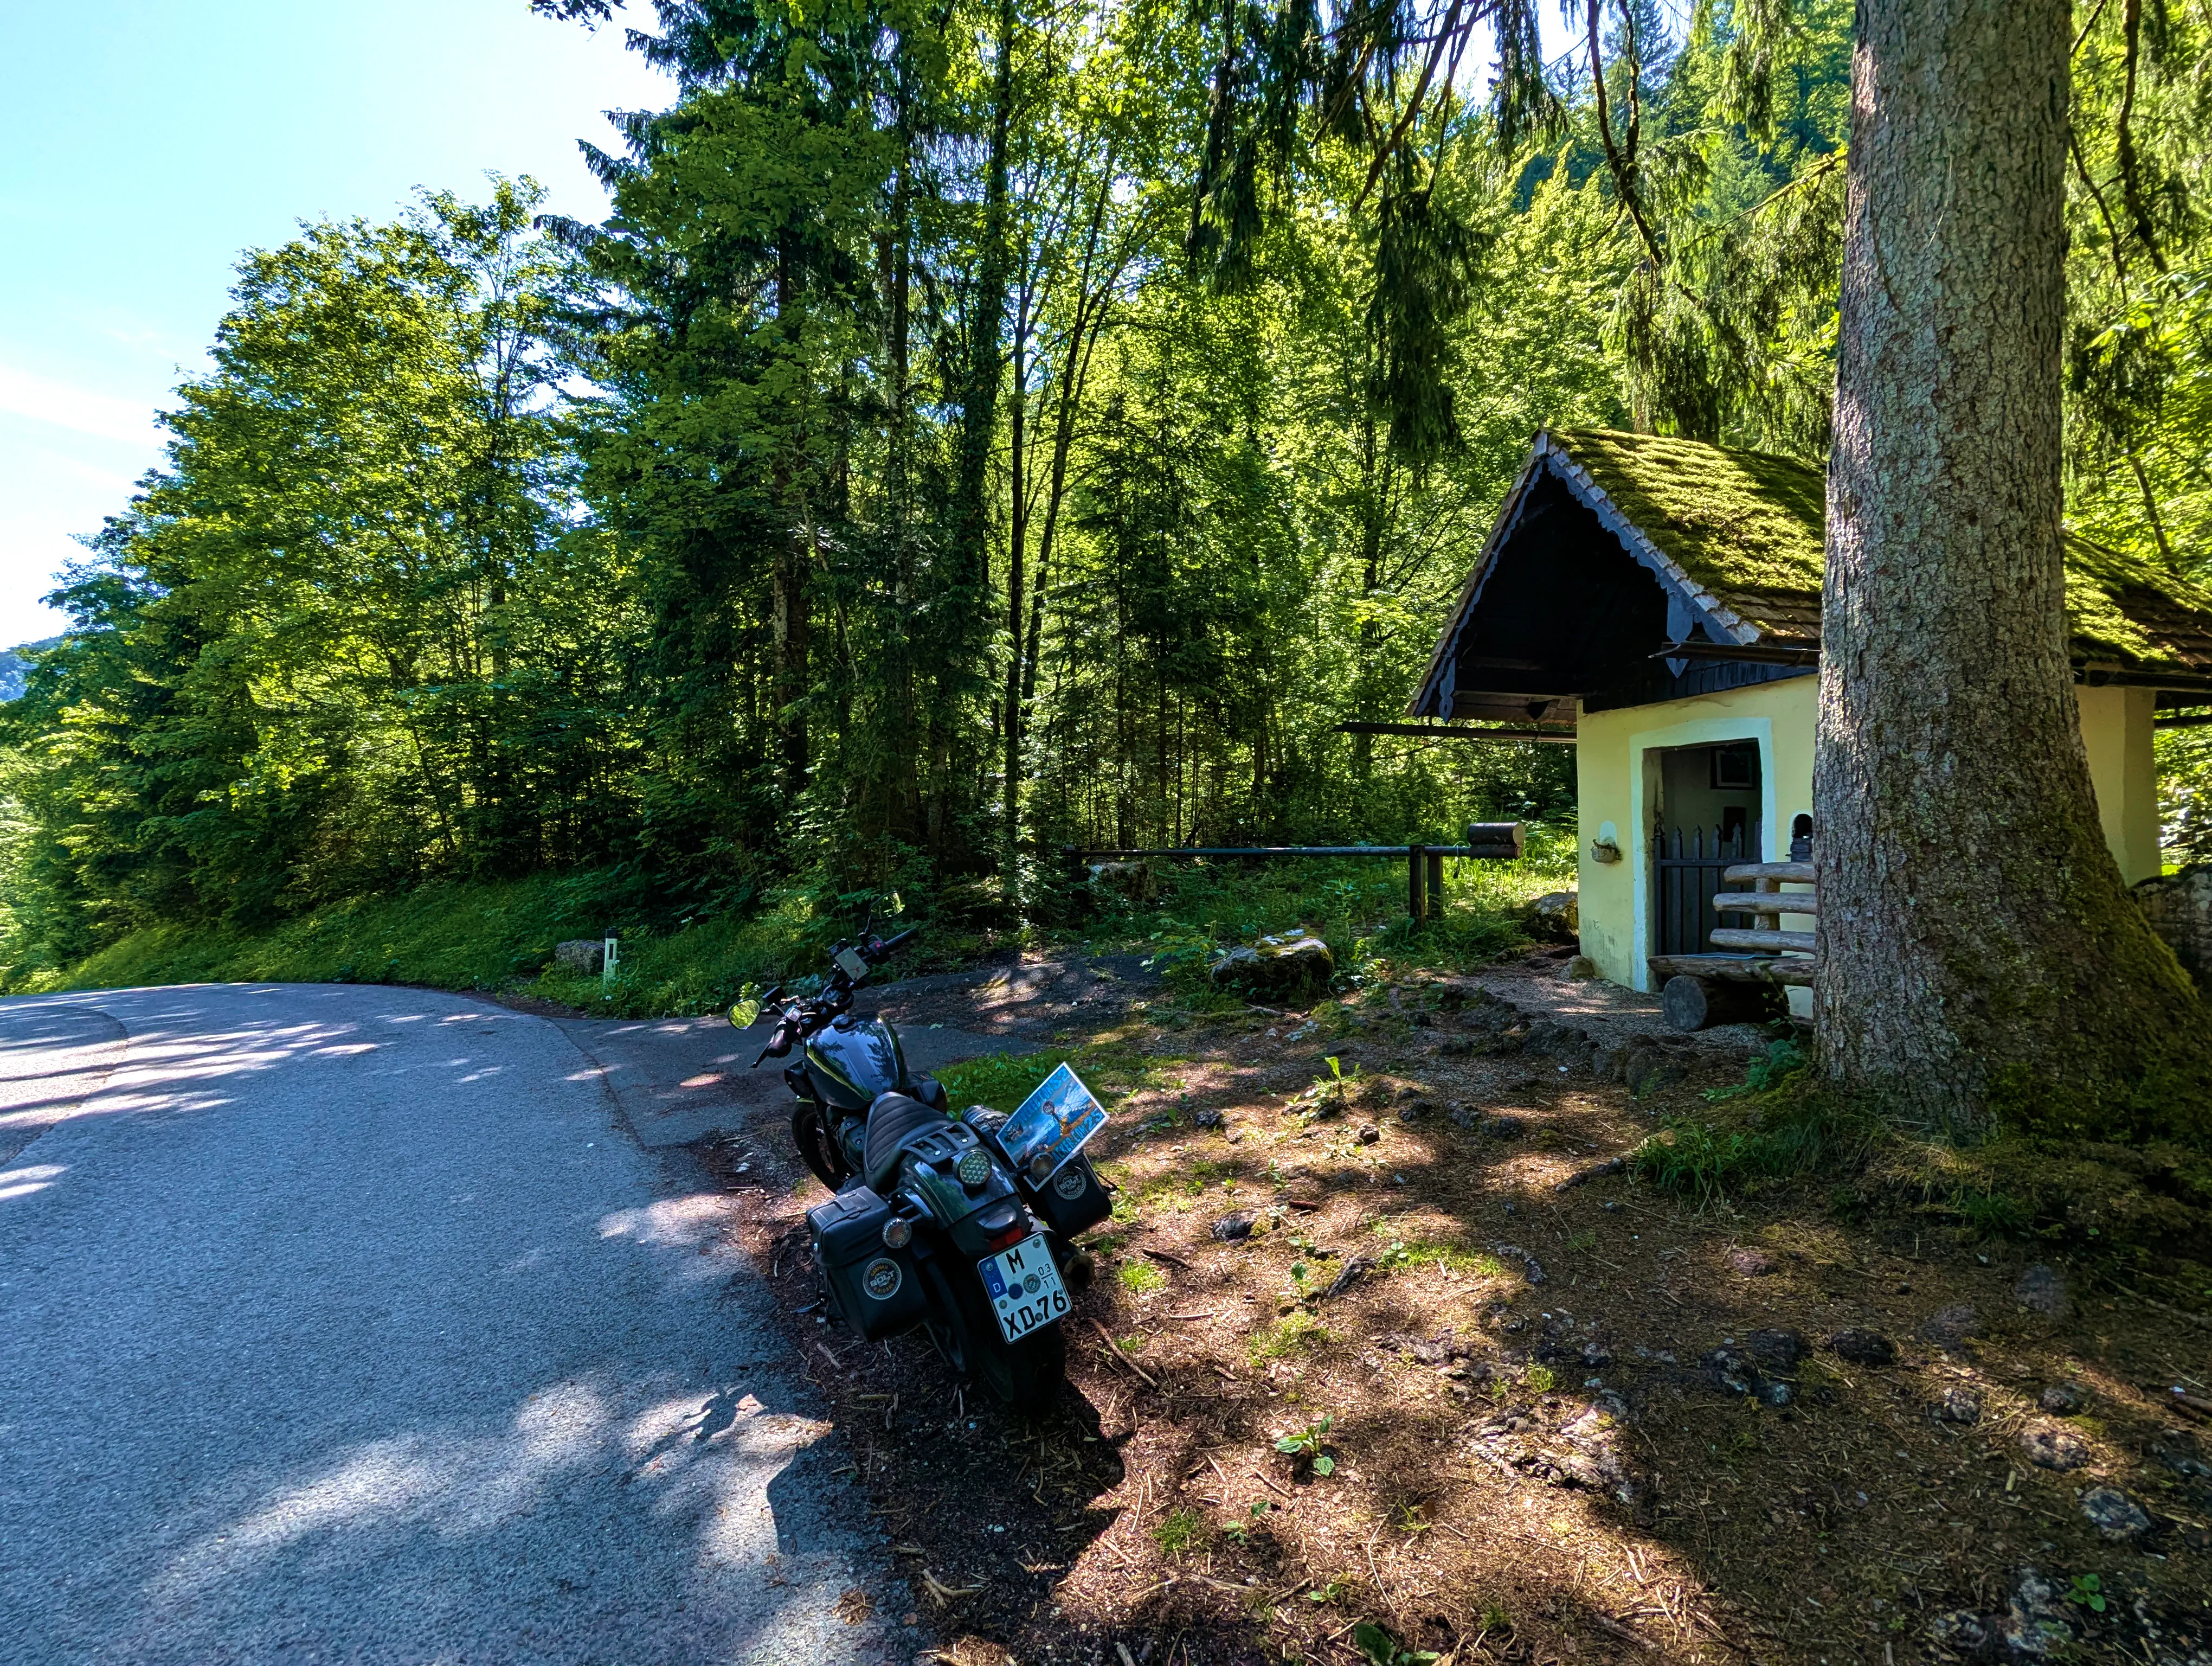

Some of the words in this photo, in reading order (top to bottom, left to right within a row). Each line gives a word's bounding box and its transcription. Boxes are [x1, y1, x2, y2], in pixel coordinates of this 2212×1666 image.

[1059, 1175, 1078, 1190] BOLT
[1006, 1248, 1025, 1274] M
[1038, 1263, 1051, 1275] 03
[870, 1270, 895, 1287] BOLT
[993, 1283, 1001, 1293] D
